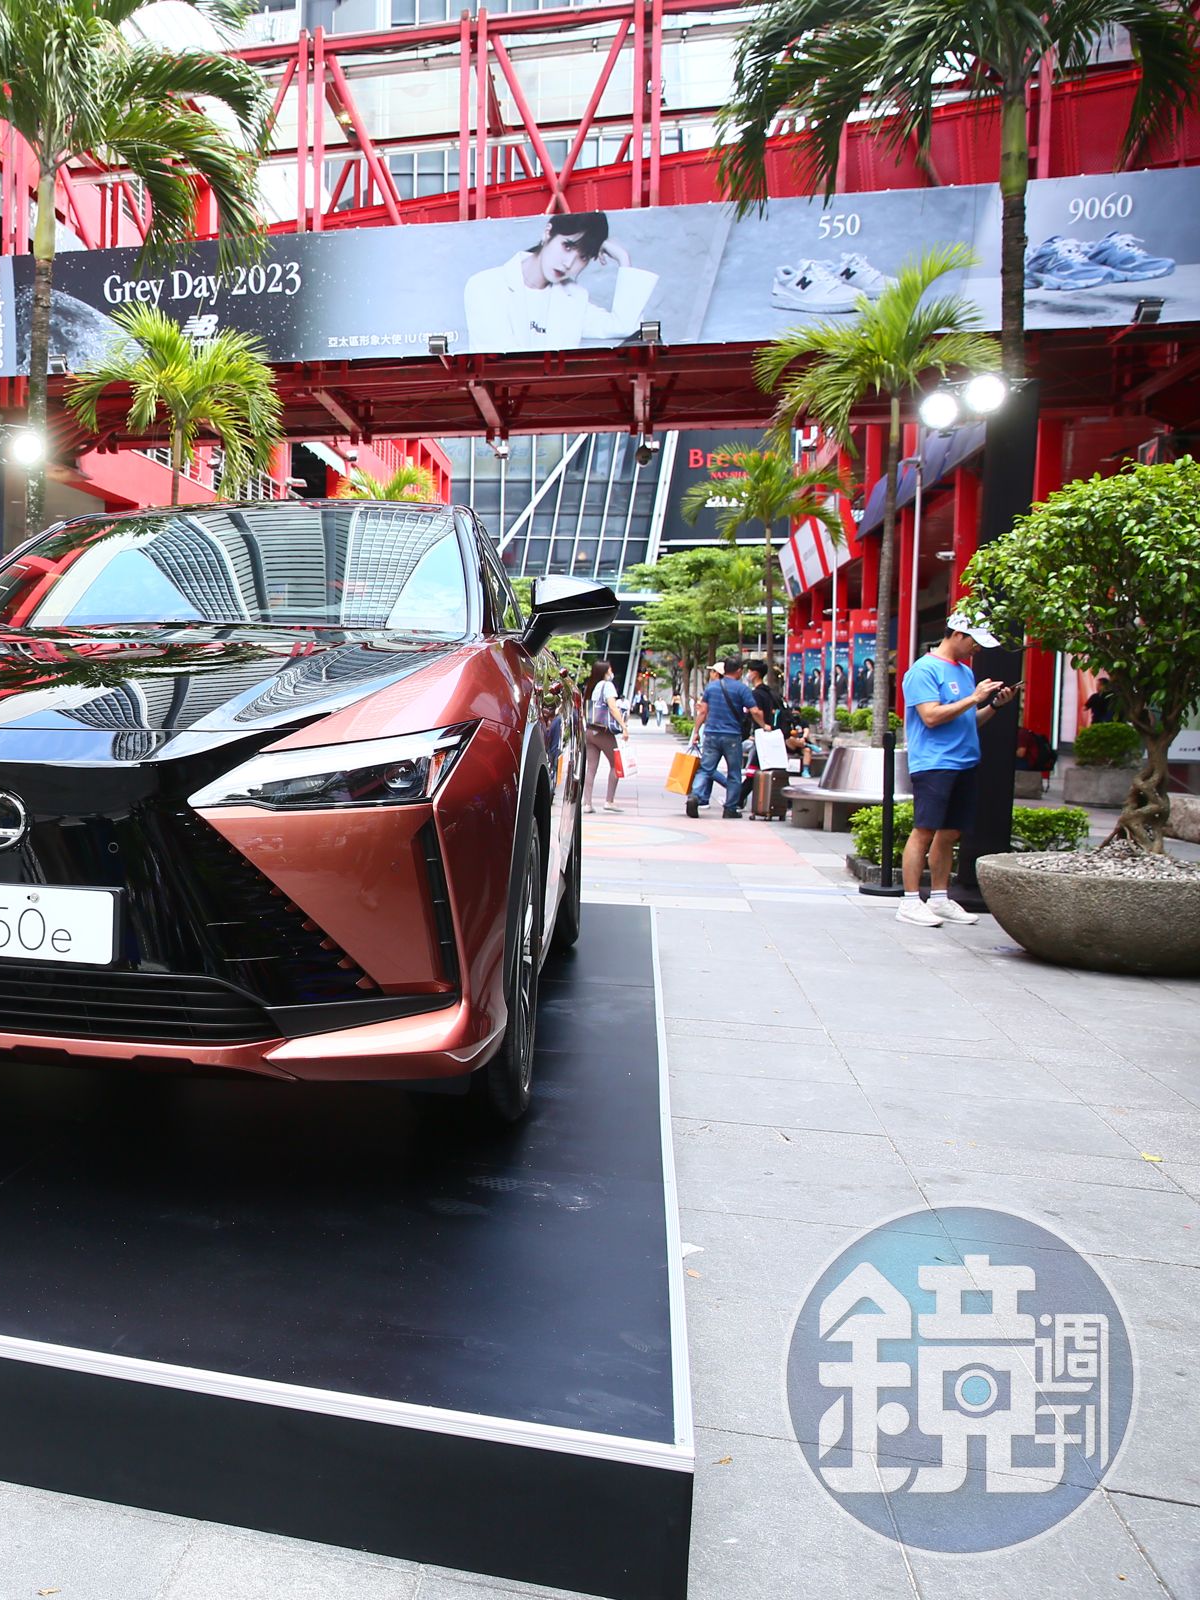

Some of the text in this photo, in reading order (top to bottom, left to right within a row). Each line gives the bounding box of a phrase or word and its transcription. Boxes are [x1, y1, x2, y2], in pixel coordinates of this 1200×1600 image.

[1068, 192, 1133, 225] 9060
[817, 213, 861, 239] 550
[103, 261, 301, 308] Grey Day 2023
[328, 335, 402, 348] 亞太區形象大使
